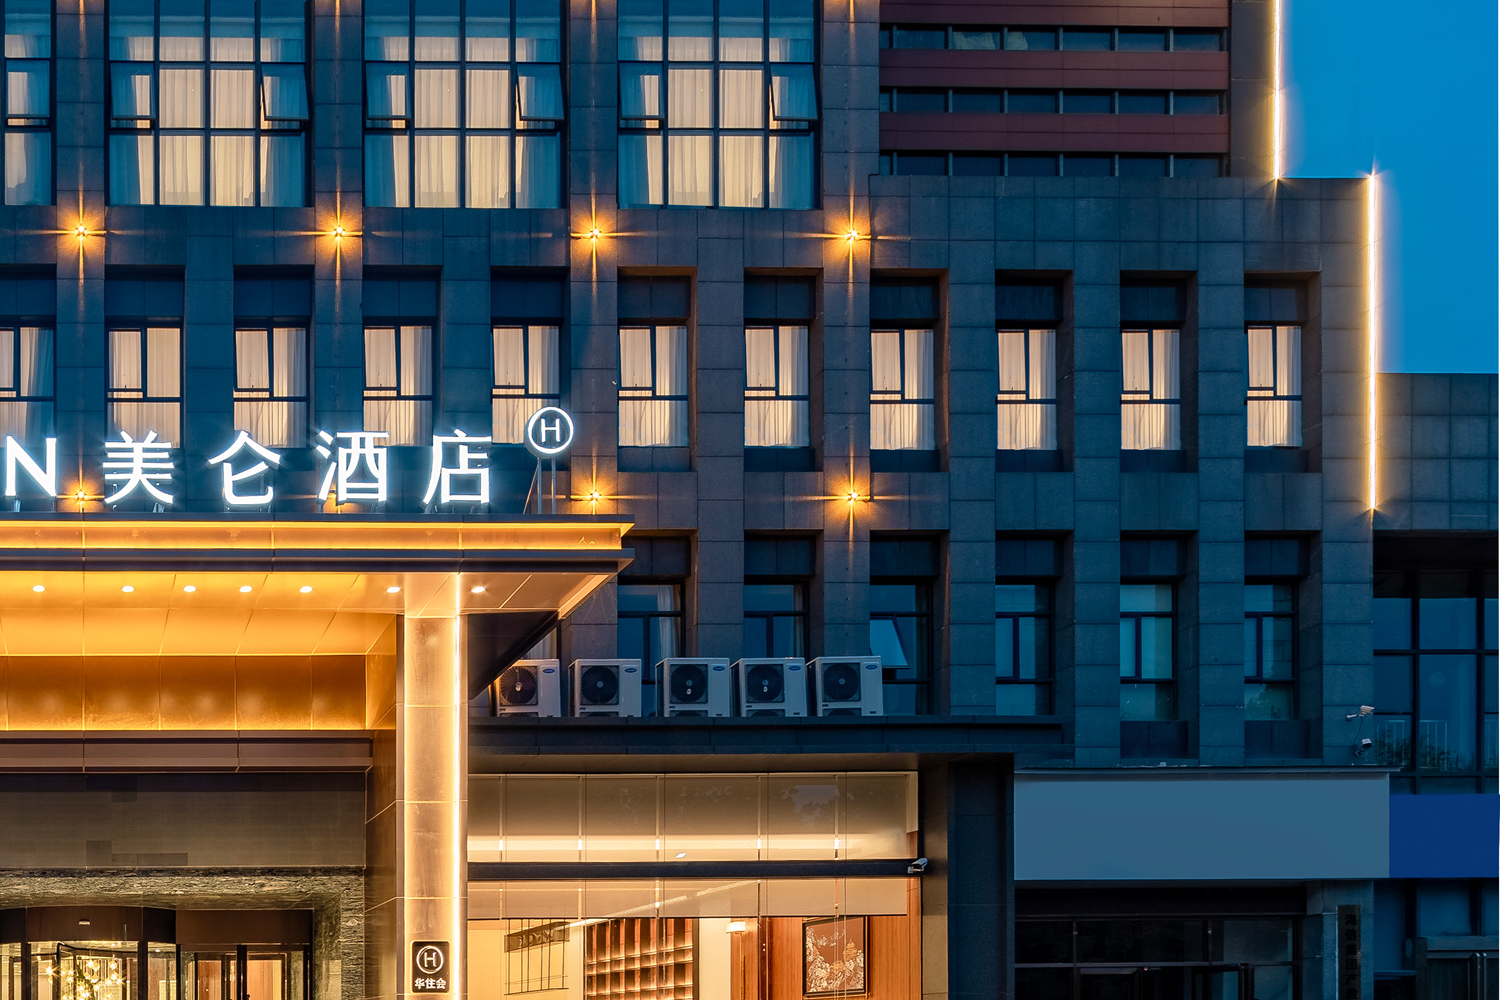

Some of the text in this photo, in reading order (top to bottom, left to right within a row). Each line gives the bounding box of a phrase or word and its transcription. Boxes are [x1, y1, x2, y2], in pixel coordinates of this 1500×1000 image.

[102, 429, 493, 507] 美仑酒店
[414, 977, 446, 989] 华住会
